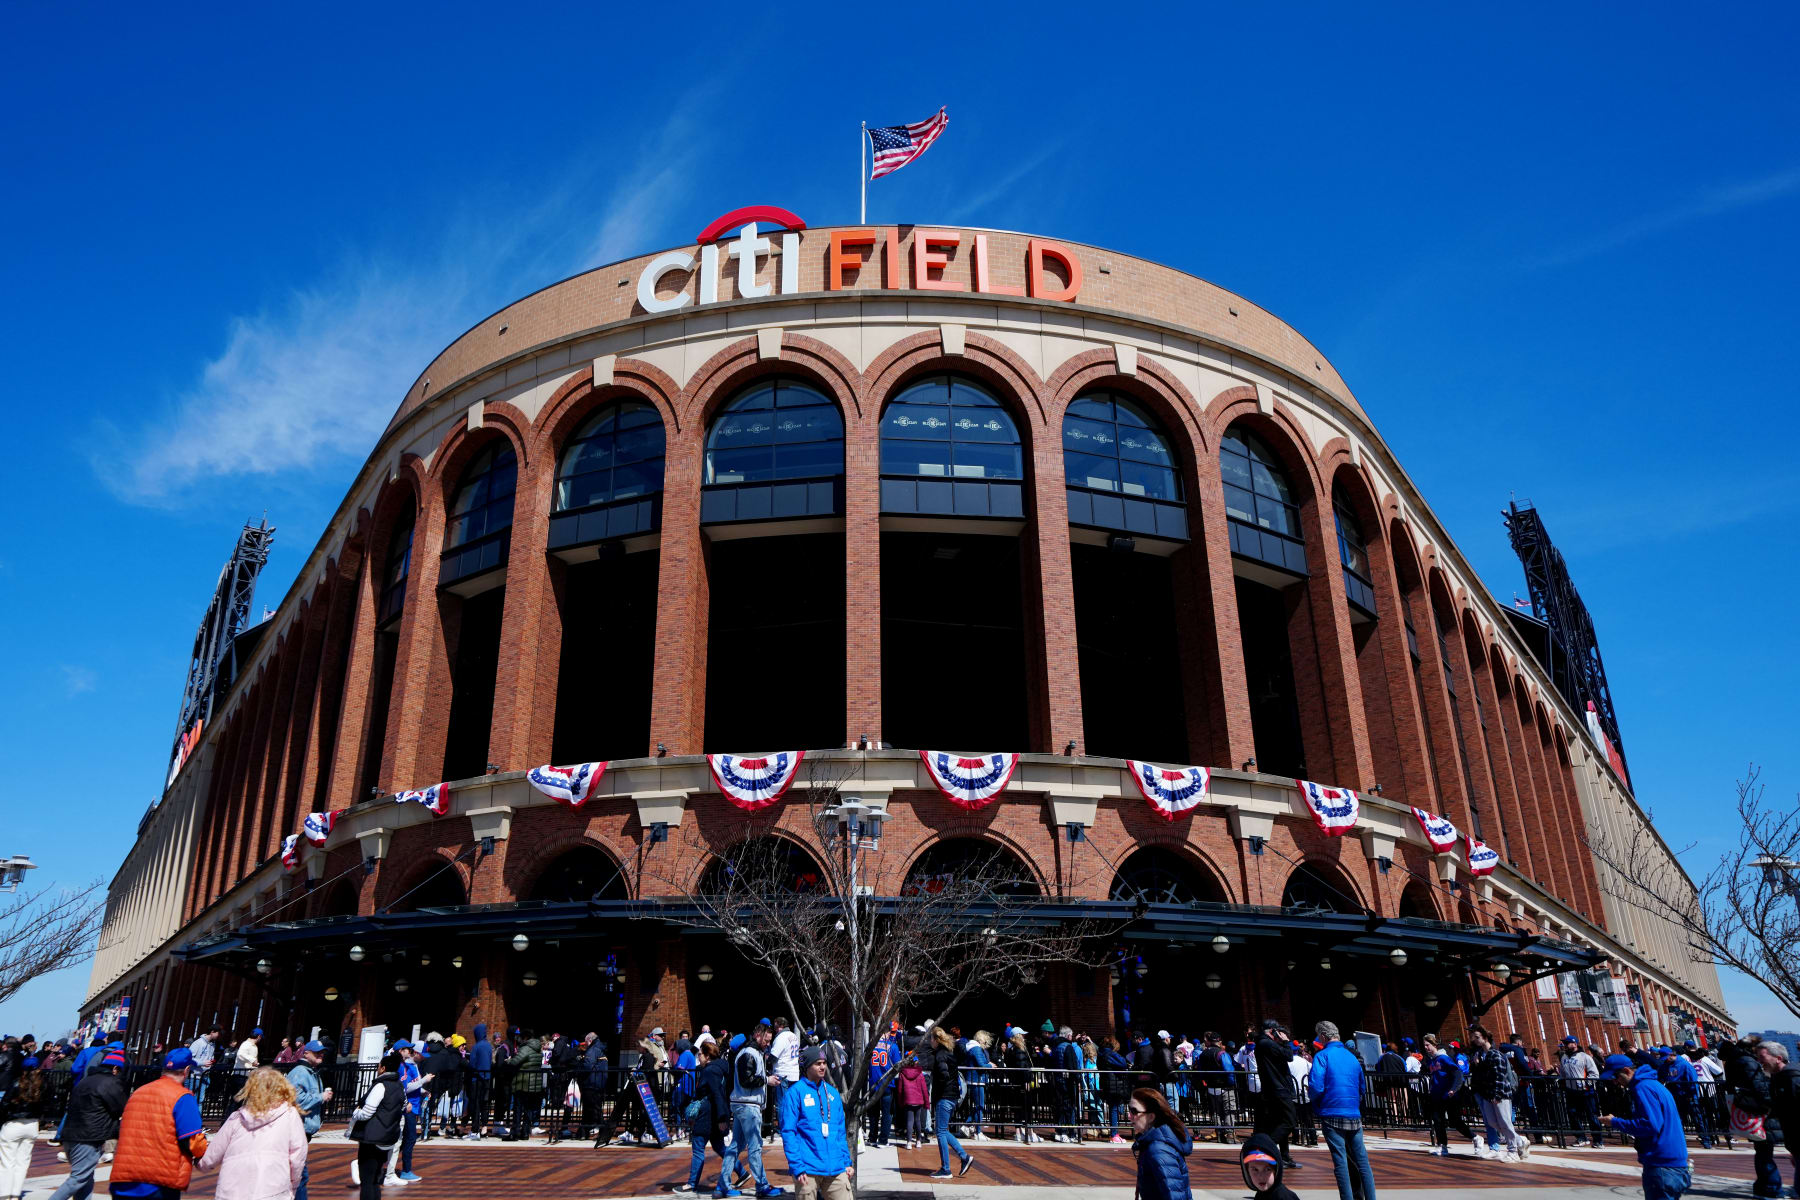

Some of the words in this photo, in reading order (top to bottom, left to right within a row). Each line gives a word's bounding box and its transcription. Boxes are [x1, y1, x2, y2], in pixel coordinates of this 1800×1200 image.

[637, 220, 800, 313] citi
[830, 229, 1083, 302] FIELD
[790, 1044, 800, 1059] 22
[871, 1050, 888, 1067] 20
